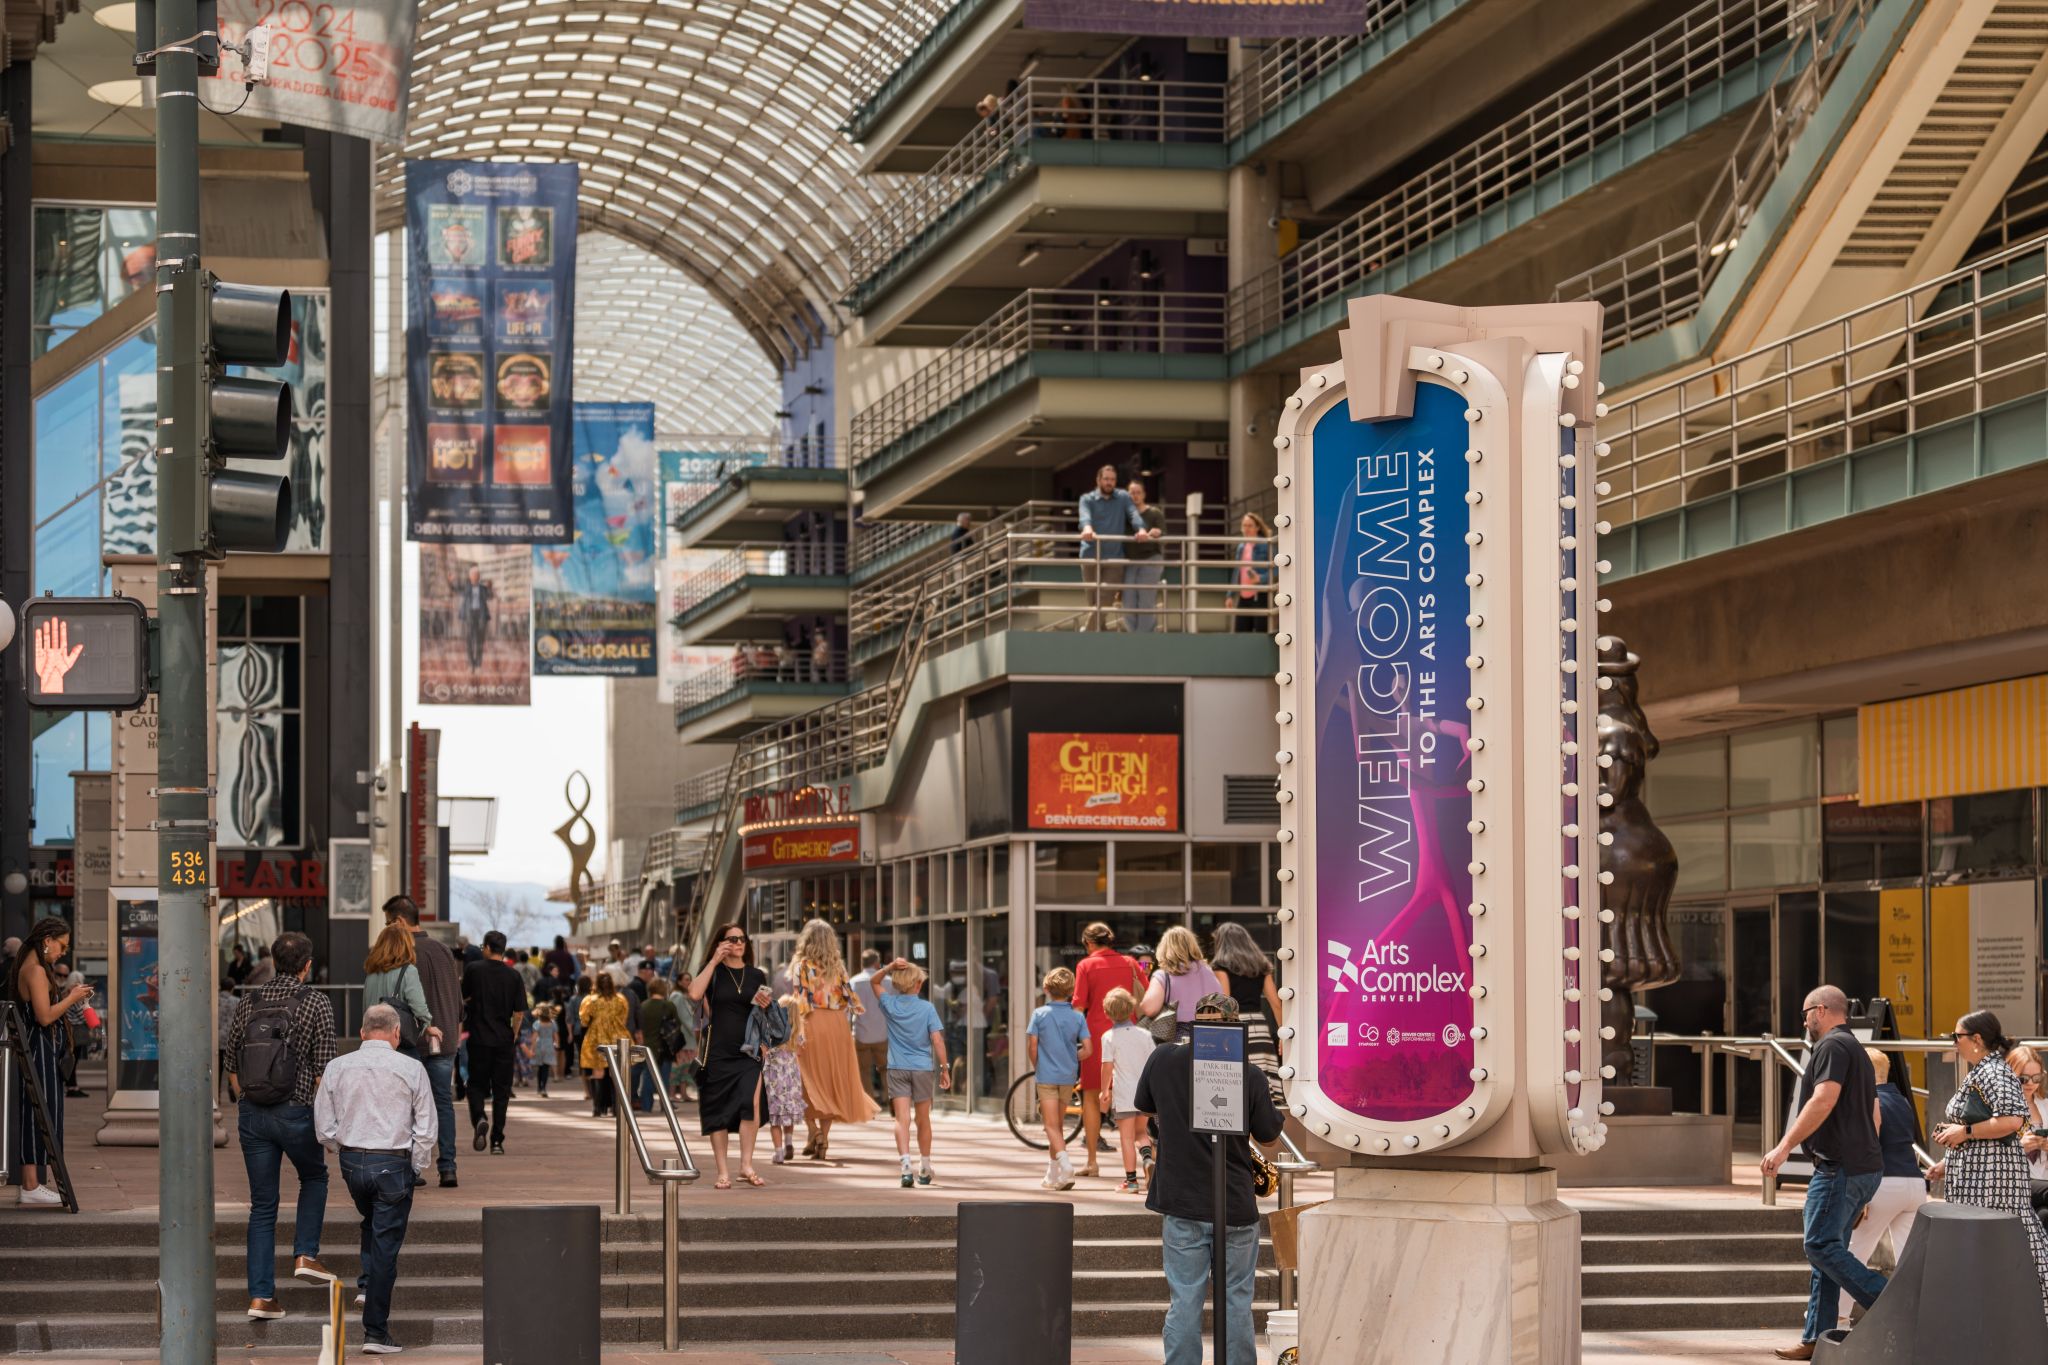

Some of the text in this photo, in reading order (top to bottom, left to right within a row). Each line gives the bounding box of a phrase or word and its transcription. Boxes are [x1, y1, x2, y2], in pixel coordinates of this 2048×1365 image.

[253, 0, 357, 41] 2024
[271, 33, 371, 81] 2025
[433, 447, 476, 470] HOT
[414, 522, 565, 537] DENVERCENTER.ORG
[1417, 448, 1436, 768] TO THE ARTS COMPLEX
[567, 643, 650, 659] CHORALE
[1356, 451, 1411, 902] WELCOME
[452, 683, 524, 696] SYMPHONY
[1044, 815, 1166, 827] DENVERCENTER.ORG
[171, 851, 204, 868] 536
[171, 869, 206, 885] 434
[1361, 940, 1410, 965] Arts
[1360, 963, 1466, 1003] Complex
[1362, 995, 1413, 1003] DENVER
[1203, 1118, 1233, 1128] SALON
